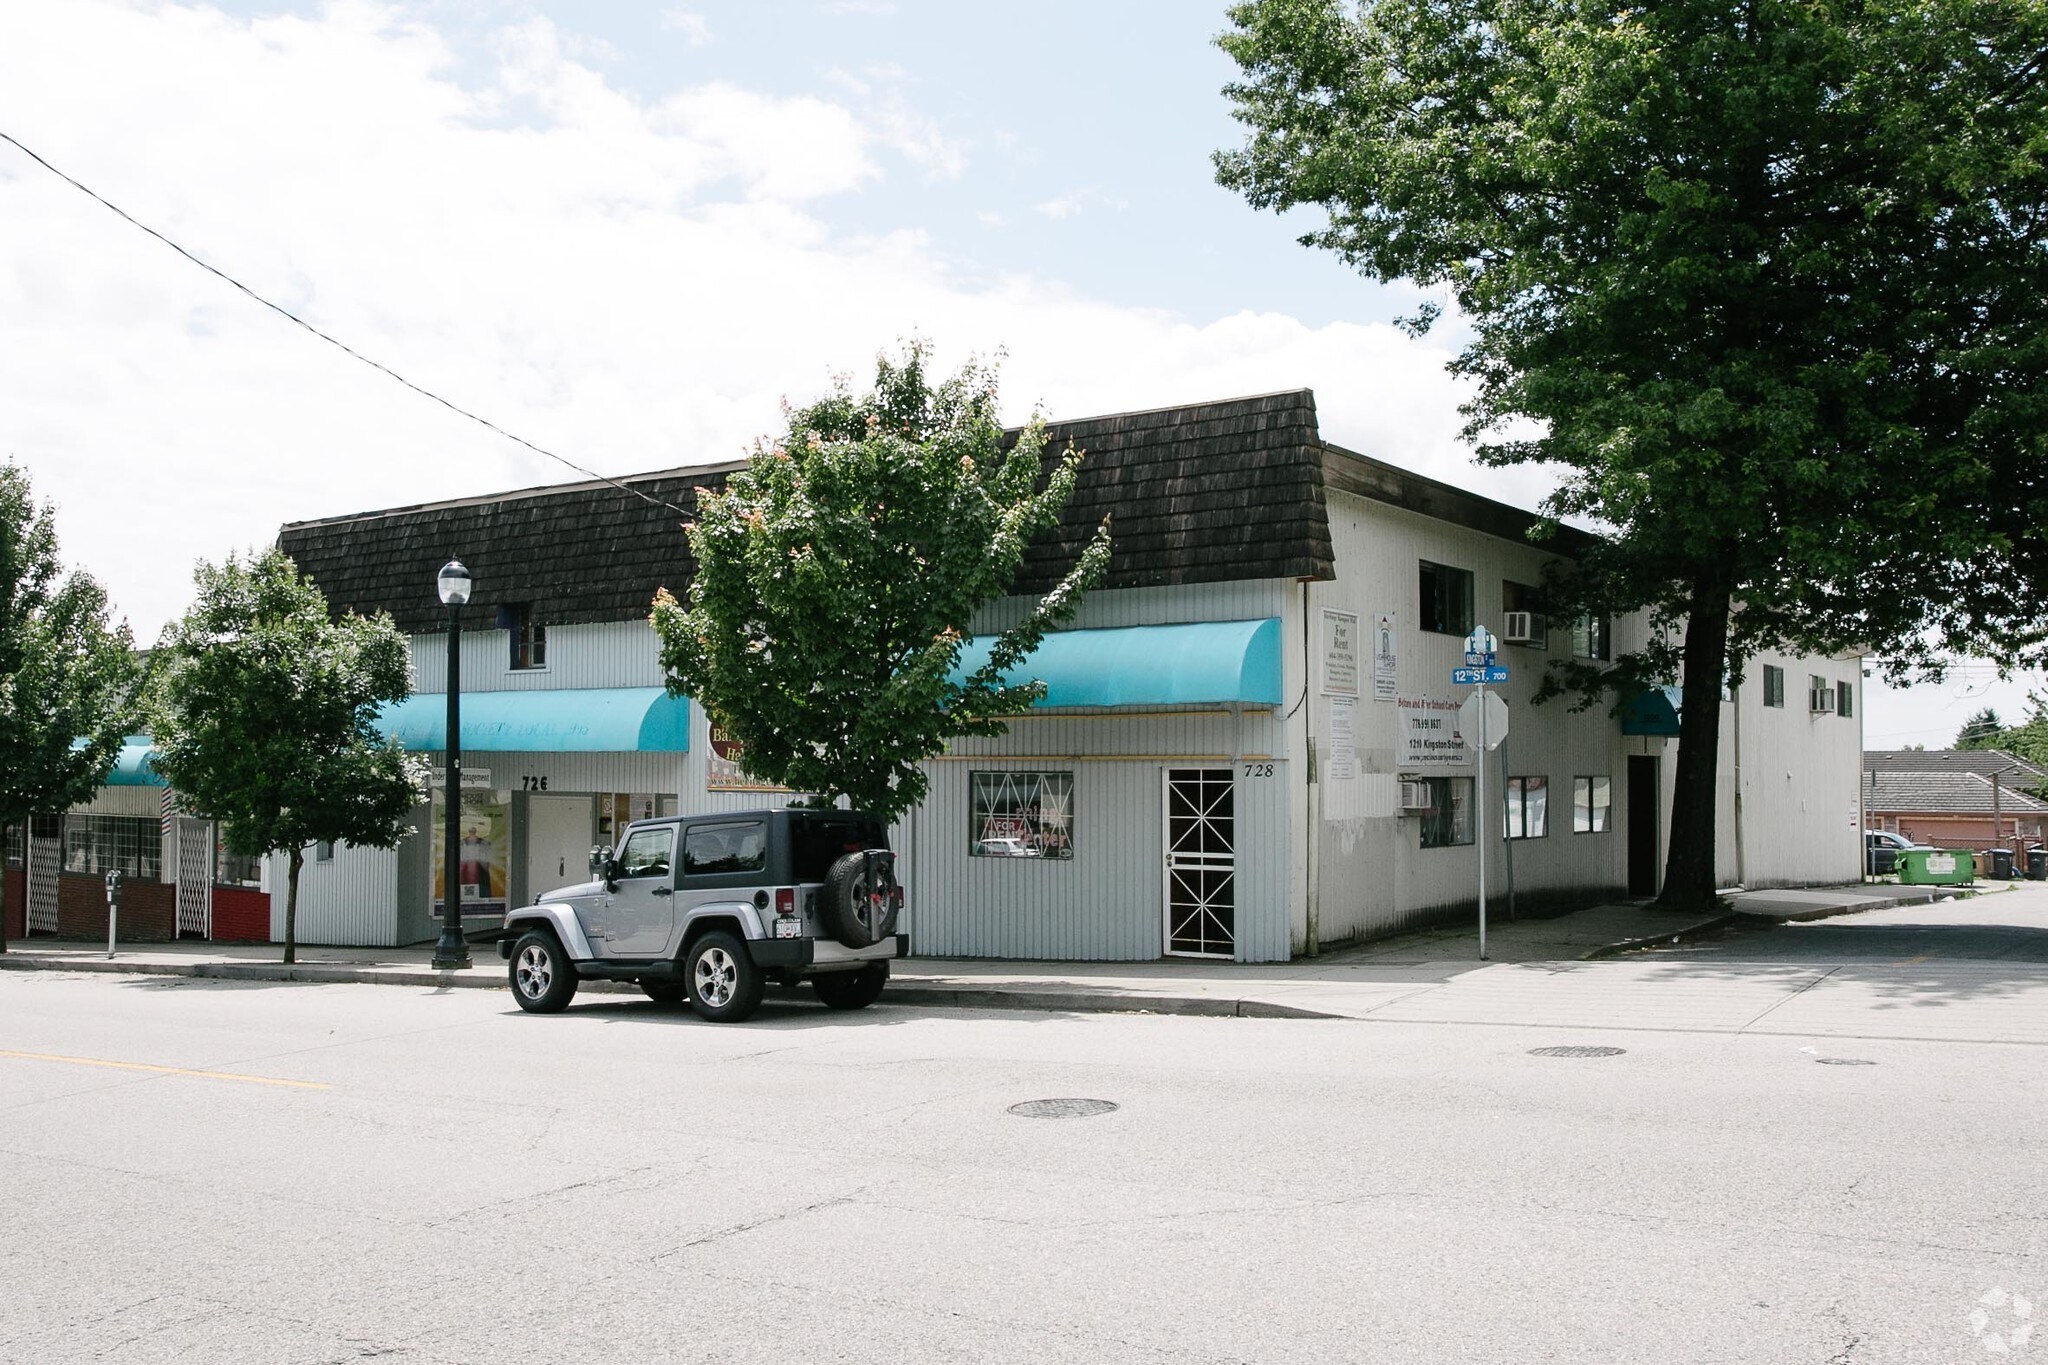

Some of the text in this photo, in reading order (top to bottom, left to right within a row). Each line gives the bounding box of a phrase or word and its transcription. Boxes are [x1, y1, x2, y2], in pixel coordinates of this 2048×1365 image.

[1335, 624, 1347, 638] For
[1333, 636, 1349, 649] Rent
[1493, 672, 1507, 680] 700
[1412, 700, 1420, 709] and
[1423, 739, 1447, 751] Kingston
[1447, 740, 1464, 750] Street
[1244, 763, 1274, 778] 728
[522, 775, 548, 791] 726
[996, 821, 1015, 831] FOR
